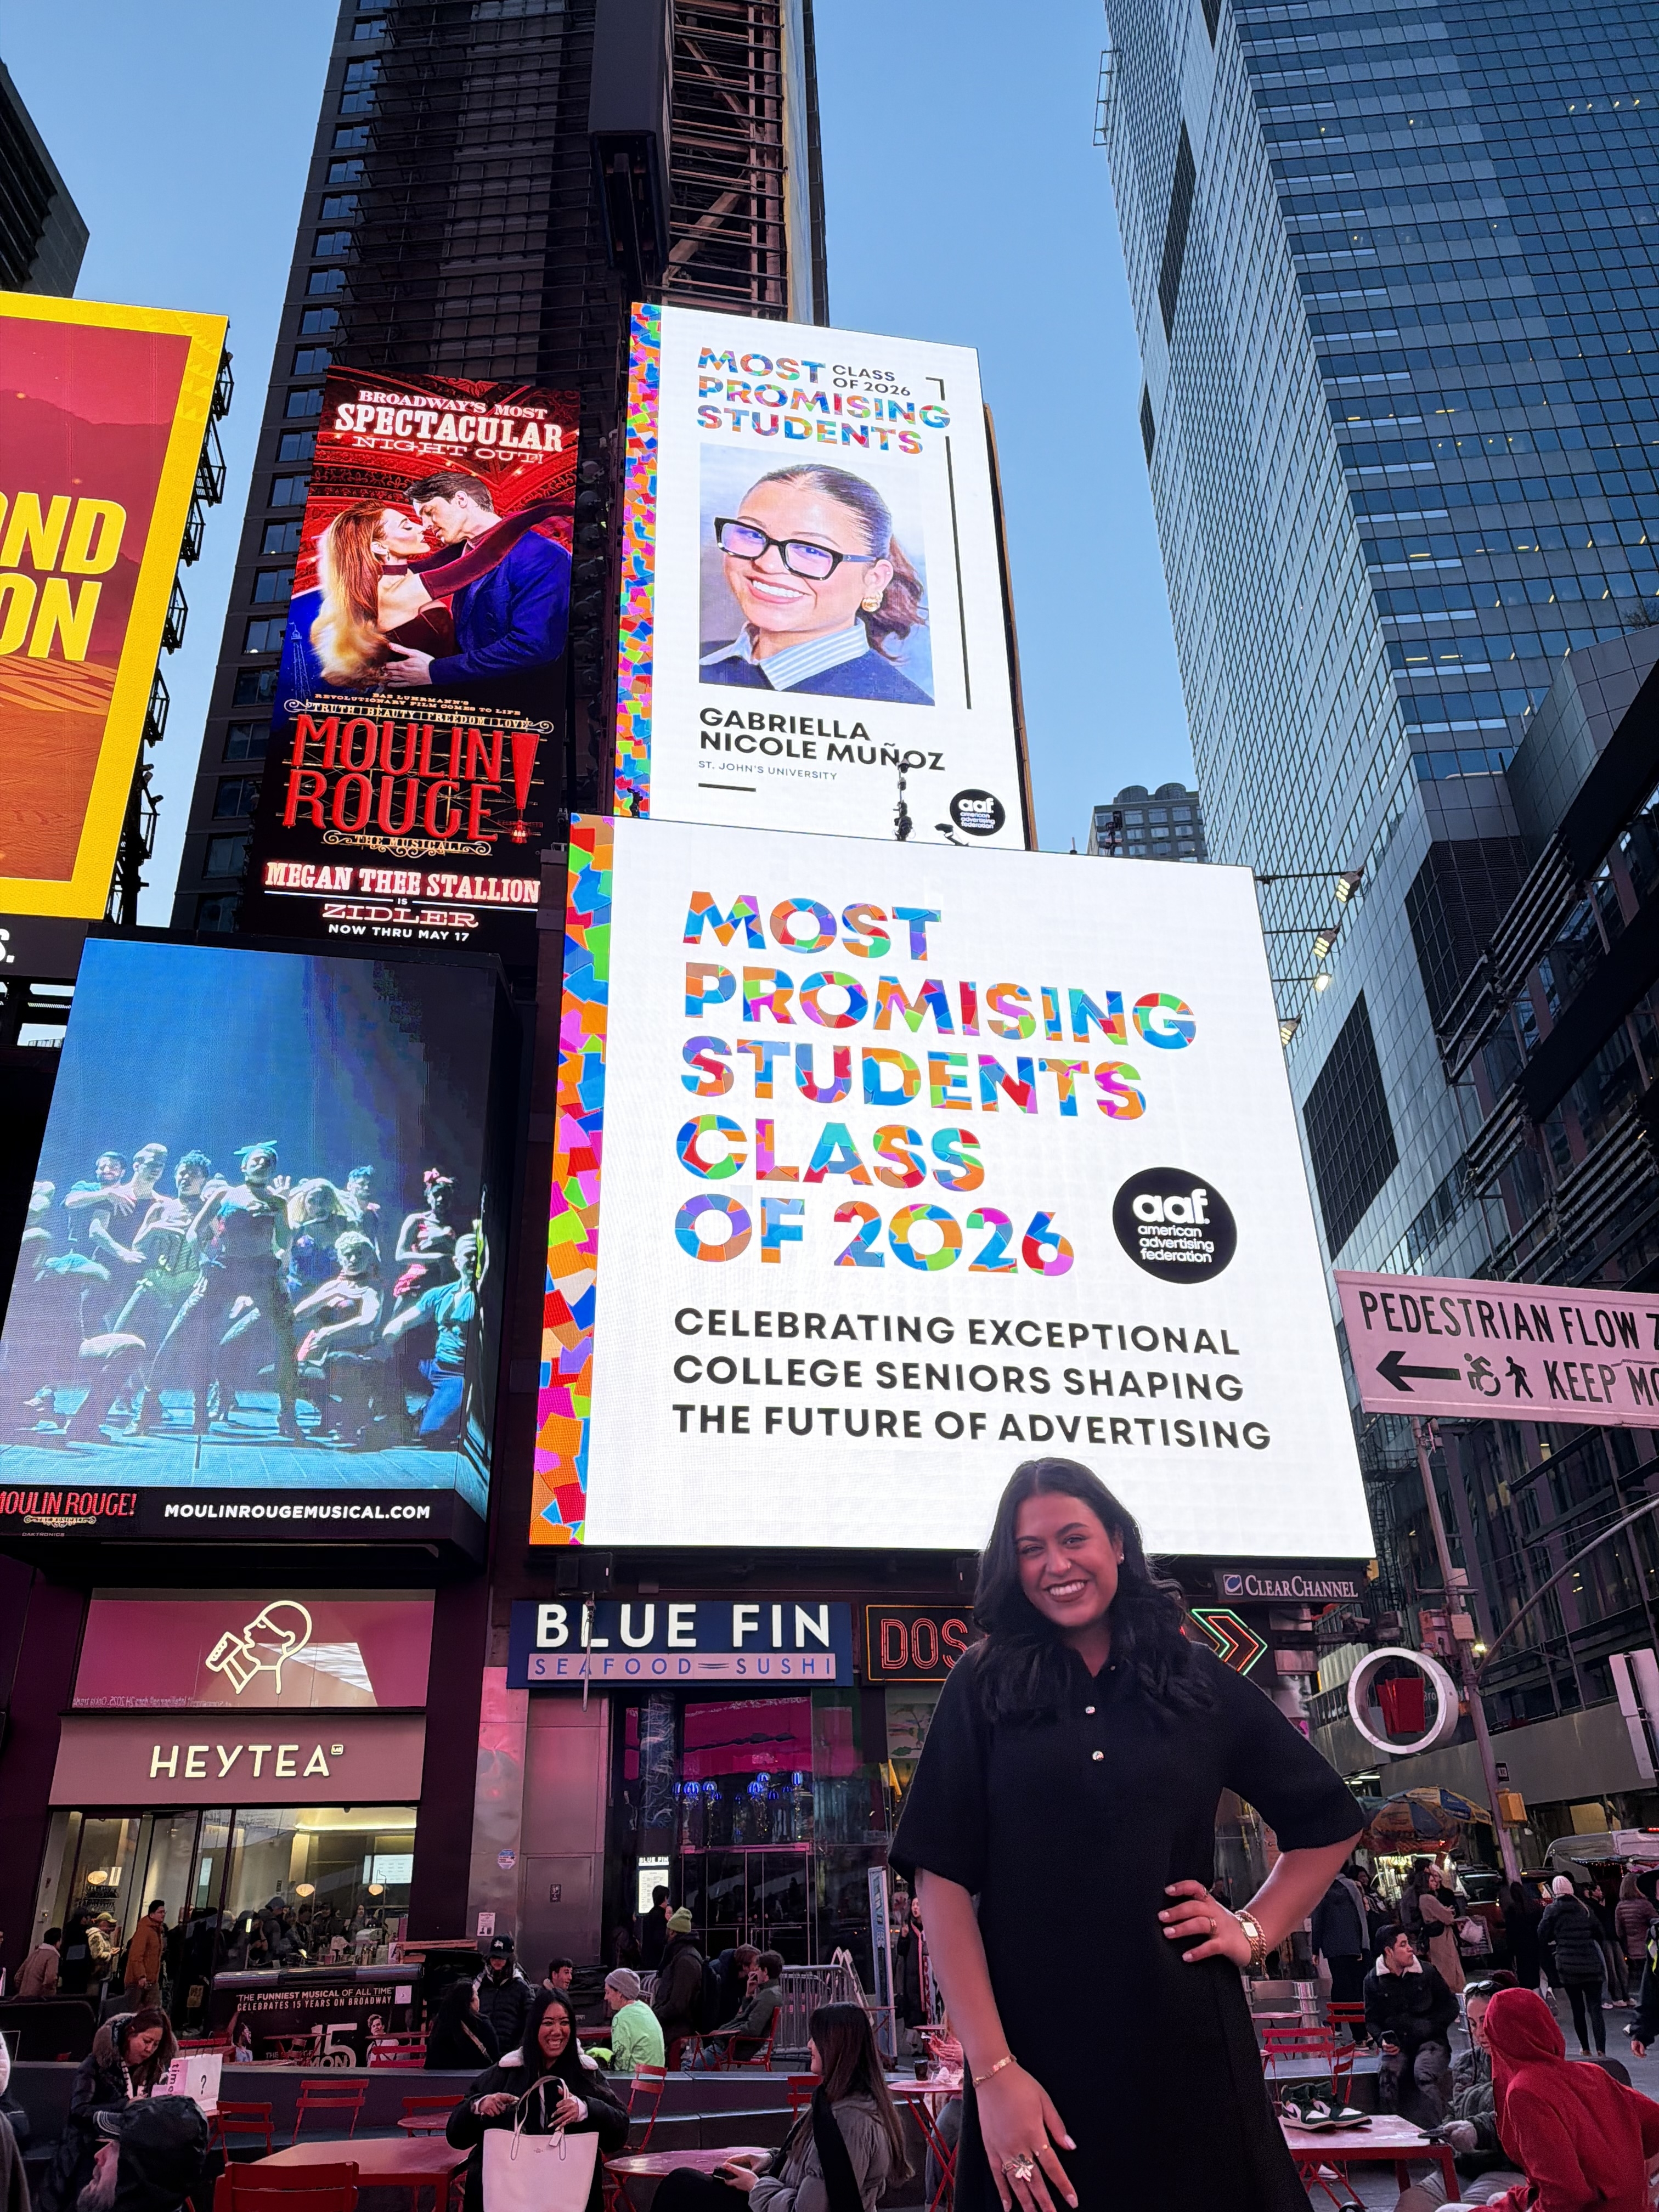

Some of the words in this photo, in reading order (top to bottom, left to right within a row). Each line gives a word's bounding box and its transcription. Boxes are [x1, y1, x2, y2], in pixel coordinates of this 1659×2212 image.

[697, 347, 826, 383] MOST
[832, 365, 895, 381] CLASS
[698, 375, 951, 428] PROMISING
[833, 377, 861, 389] OF
[863, 381, 911, 397] 2026
[358, 390, 486, 414] BROADWAY'S
[494, 404, 548, 420] MOST
[335, 403, 563, 453] SPECTACULAR
[696, 404, 923, 454] STUDENTS
[352, 436, 467, 456] NIGHT
[475, 447, 544, 464] OUT!
[0, 492, 127, 574] ND
[314, 693, 407, 707] REVOLUTIONARY
[440, 704, 476, 712] COMES
[314, 703, 356, 715] TRUTH
[366, 706, 415, 720] BEAUTY
[427, 712, 485, 726] FREEDOM
[497, 718, 528, 729] LOVE
[397, 695, 470, 706] LUHRMANN'S
[699, 707, 871, 741] GABRIELLA
[291, 714, 504, 783] MOULIN
[700, 730, 817, 760] NICOLE
[827, 742, 945, 771] MUÑOZ
[698, 760, 715, 769] ST.
[719, 763, 764, 774] JOHN'S
[768, 767, 837, 781] UNIVERSITY
[958, 798, 994, 813] aaf
[354, 834, 381, 846] THE
[389, 837, 462, 852] MUSICAL!
[265, 861, 353, 891] MEGAN
[358, 868, 421, 896] THEE
[426, 873, 541, 904] STALLION
[322, 904, 478, 928] ZIDLER
[328, 924, 366, 935] NOW
[372, 927, 412, 938] THRU
[418, 930, 450, 941] MAY
[455, 932, 470, 942] 17
[683, 890, 941, 961] MOST
[685, 962, 1197, 1050] PROMISING
[680, 1035, 1147, 1120] STUDENTS
[675, 1114, 985, 1193] CLASS
[1132, 1188, 1210, 1224] aaf
[675, 1192, 805, 1263] OF
[833, 1200, 1075, 1277] 2026
[1137, 1225, 1203, 1237] american
[1139, 1236, 1215, 1252] advertising
[1140, 1248, 1212, 1262] federation
[674, 1307, 956, 1344] CELEBRATING
[969, 1318, 1240, 1357] EXCEPTIONAL
[1358, 1291, 1555, 1344] PEDESTRIAN
[1559, 1306, 1640, 1350] FLOW
[673, 1355, 862, 1389] COLLEGE
[876, 1361, 1052, 1395] SENIORS
[1063, 1367, 1245, 1402] SHAPING
[1543, 1359, 1616, 1404] KEEP
[673, 1404, 751, 1435] THE
[765, 1406, 922, 1439] FUTURE
[934, 1410, 988, 1441] OF
[998, 1413, 1272, 1451] ADVERTISING
[64, 1492, 137, 1516] ROUGE!
[164, 1503, 431, 1520] MOULINROUGEMUSICAL.COM
[536, 1604, 696, 1647] BLUE
[733, 1604, 830, 1647] FIN
[880, 1618, 968, 1669] DOS
[534, 1657, 692, 1675] SEAFOOD
[736, 1657, 833, 1675] SUSHI
[149, 1744, 330, 1779] HEYTEA
[237, 2001, 289, 2012] CELEBRATES
[292, 2000, 301, 2009] 15
[304, 1999, 330, 2008] YEARS
[334, 1998, 345, 2006] ON
[348, 1996, 391, 2005] BROADWAY
[257, 1991, 300, 2001] FUNNIEST
[301, 1990, 339, 1999] MUSICAL
